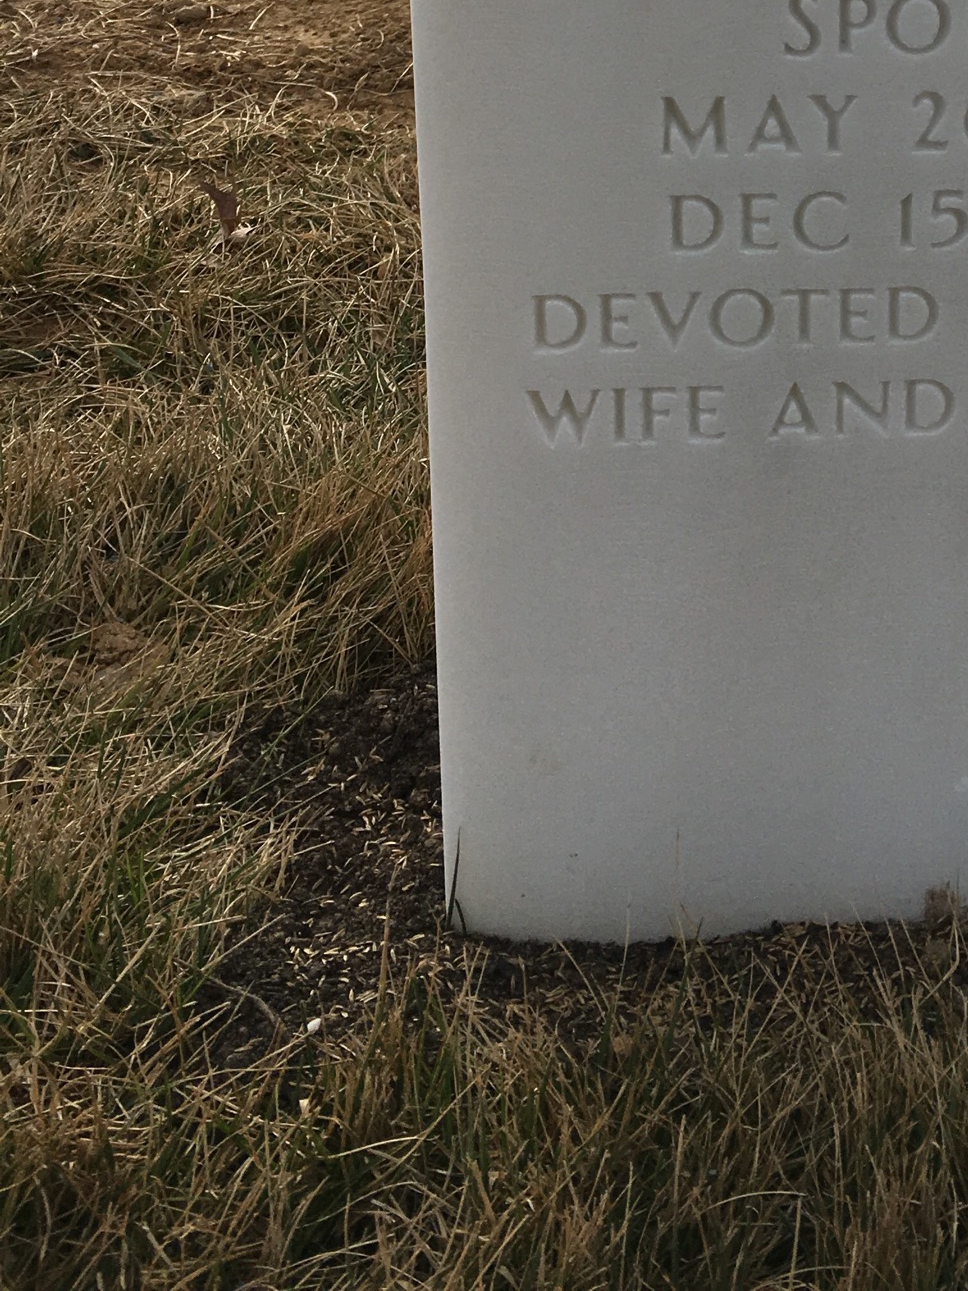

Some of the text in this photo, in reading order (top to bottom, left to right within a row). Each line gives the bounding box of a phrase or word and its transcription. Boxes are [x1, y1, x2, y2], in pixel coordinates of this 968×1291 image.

[660, 92, 858, 156] MAY
[668, 190, 850, 253] DEC
[532, 286, 939, 351] DEVOTED
[526, 385, 727, 448] WIFE
[769, 376, 956, 443] AND
